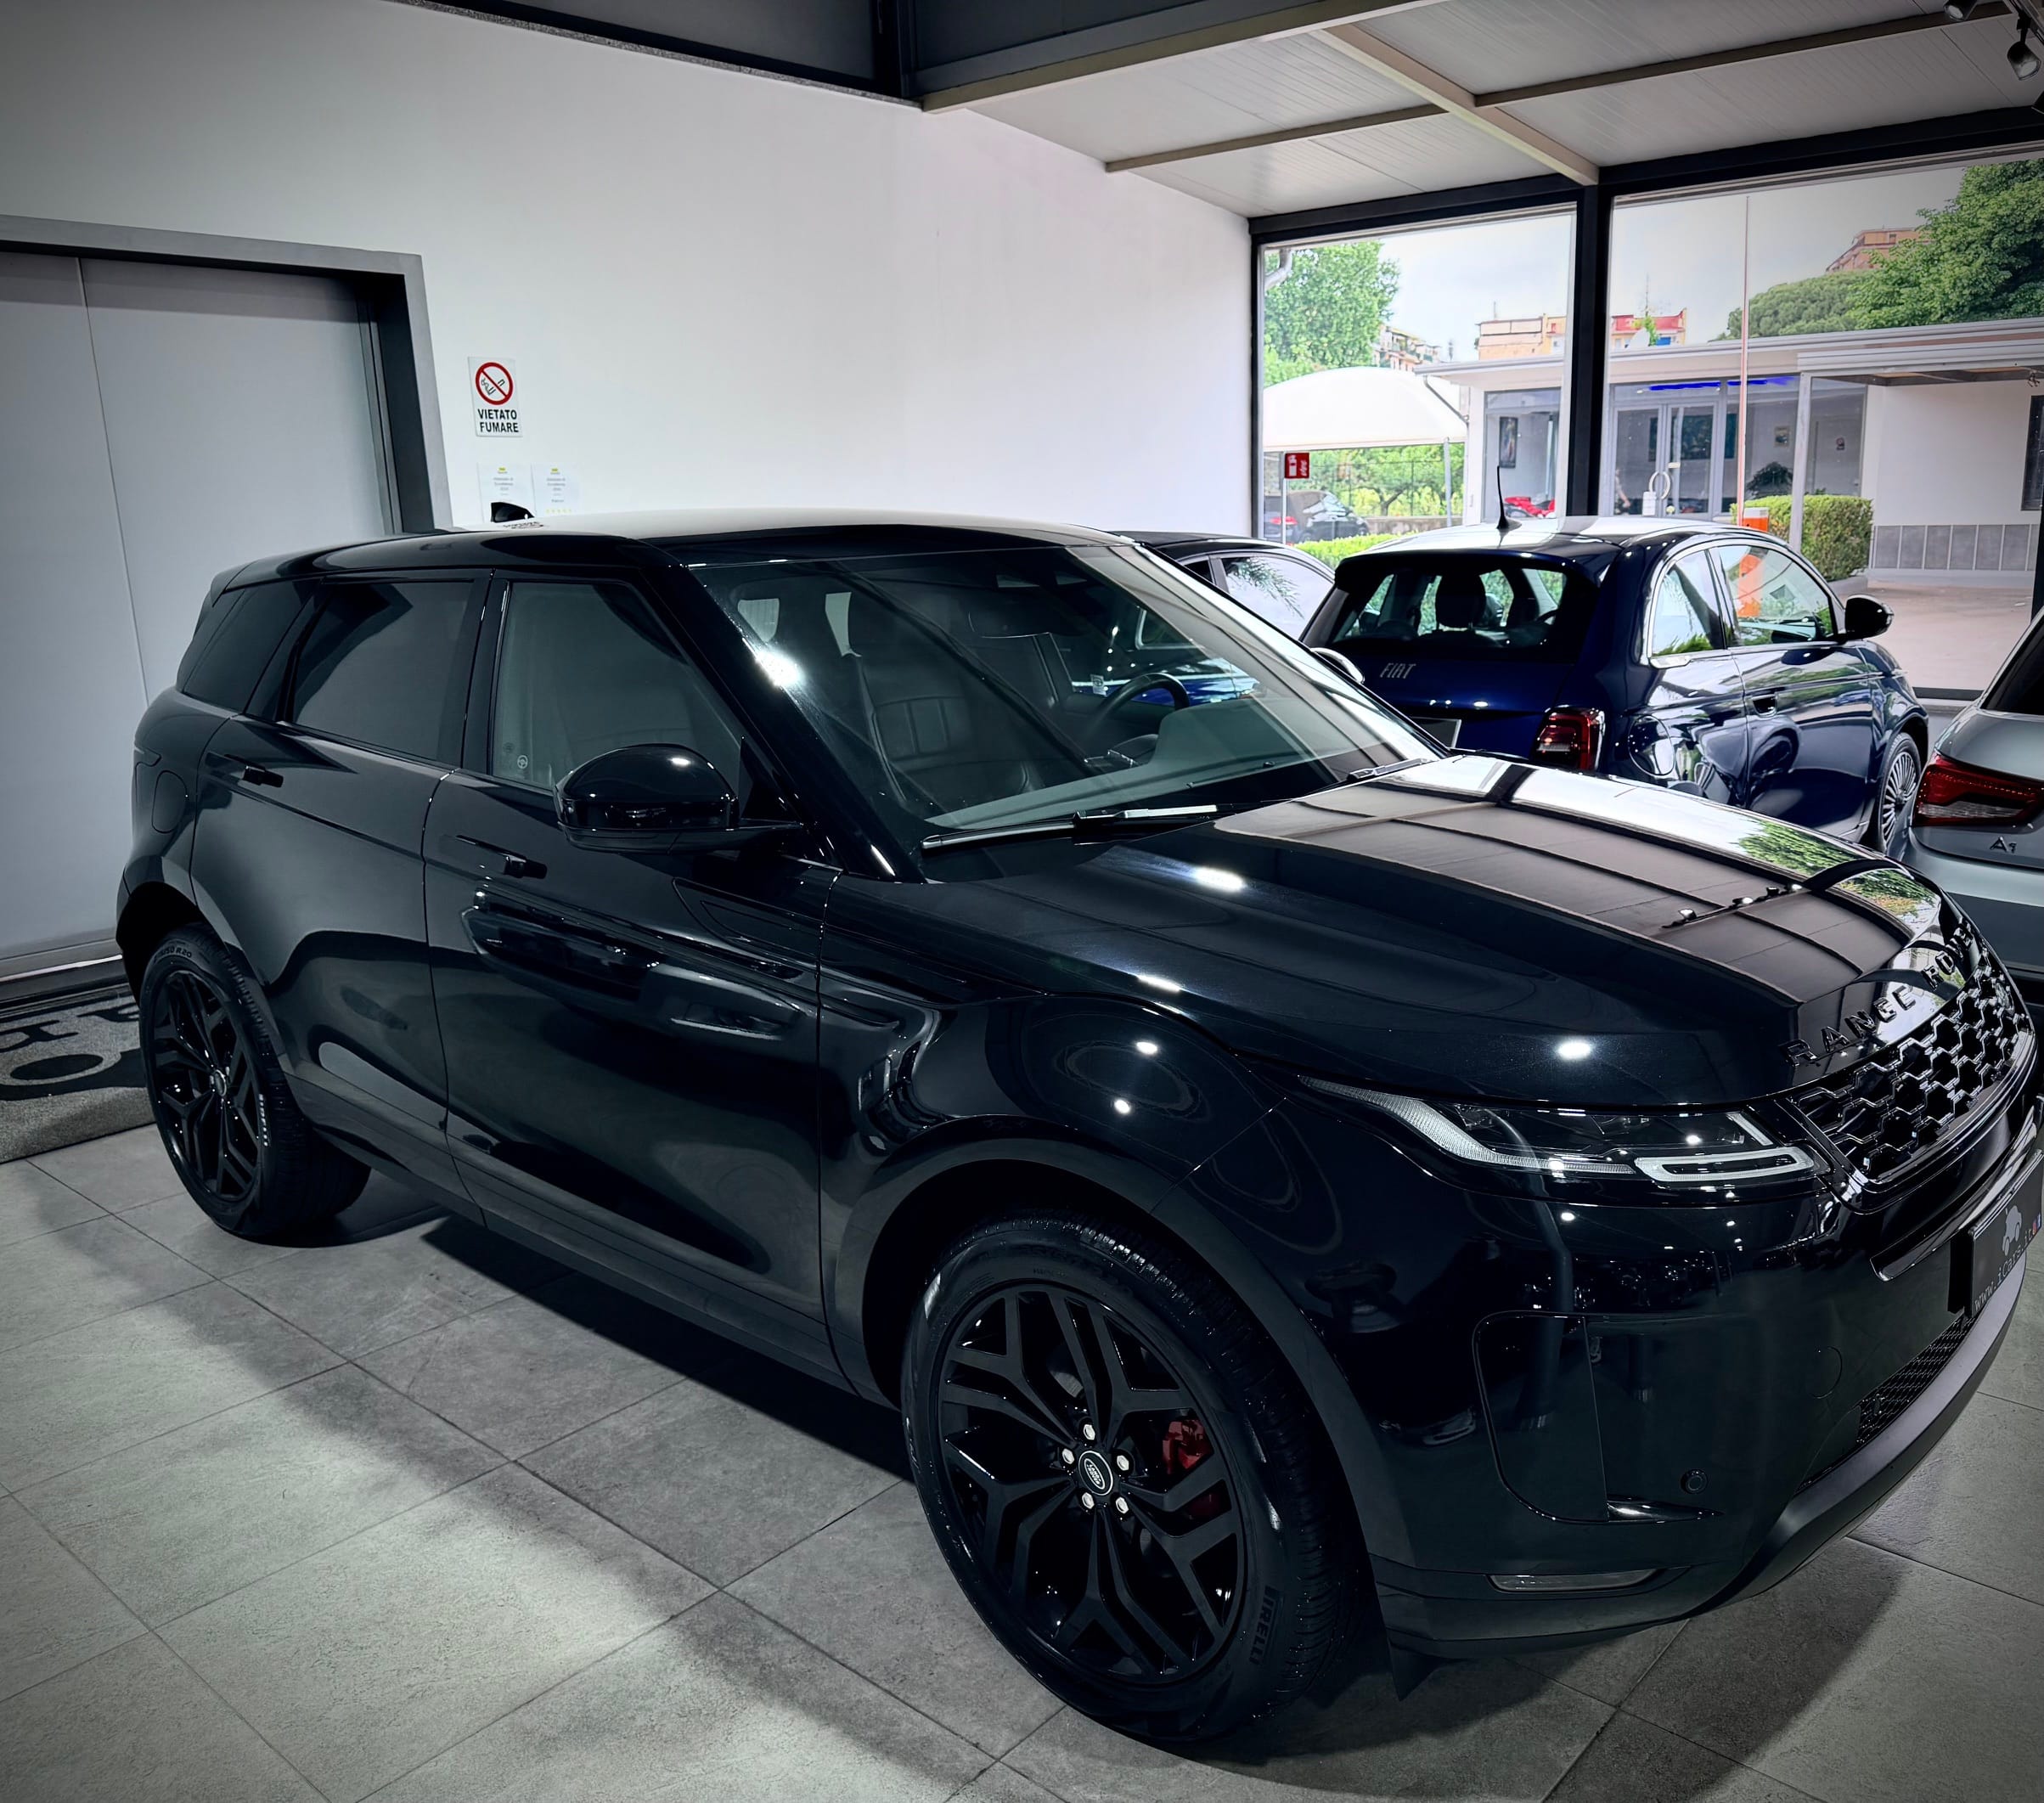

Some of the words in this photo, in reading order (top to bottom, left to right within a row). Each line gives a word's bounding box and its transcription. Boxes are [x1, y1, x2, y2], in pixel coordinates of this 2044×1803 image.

[477, 408, 517, 420] VIETATO
[480, 421, 519, 433] FUMARE
[1380, 662, 1416, 679] FIAT
[1990, 836, 2017, 854] A1
[1777, 985, 1917, 1067] RANGE
